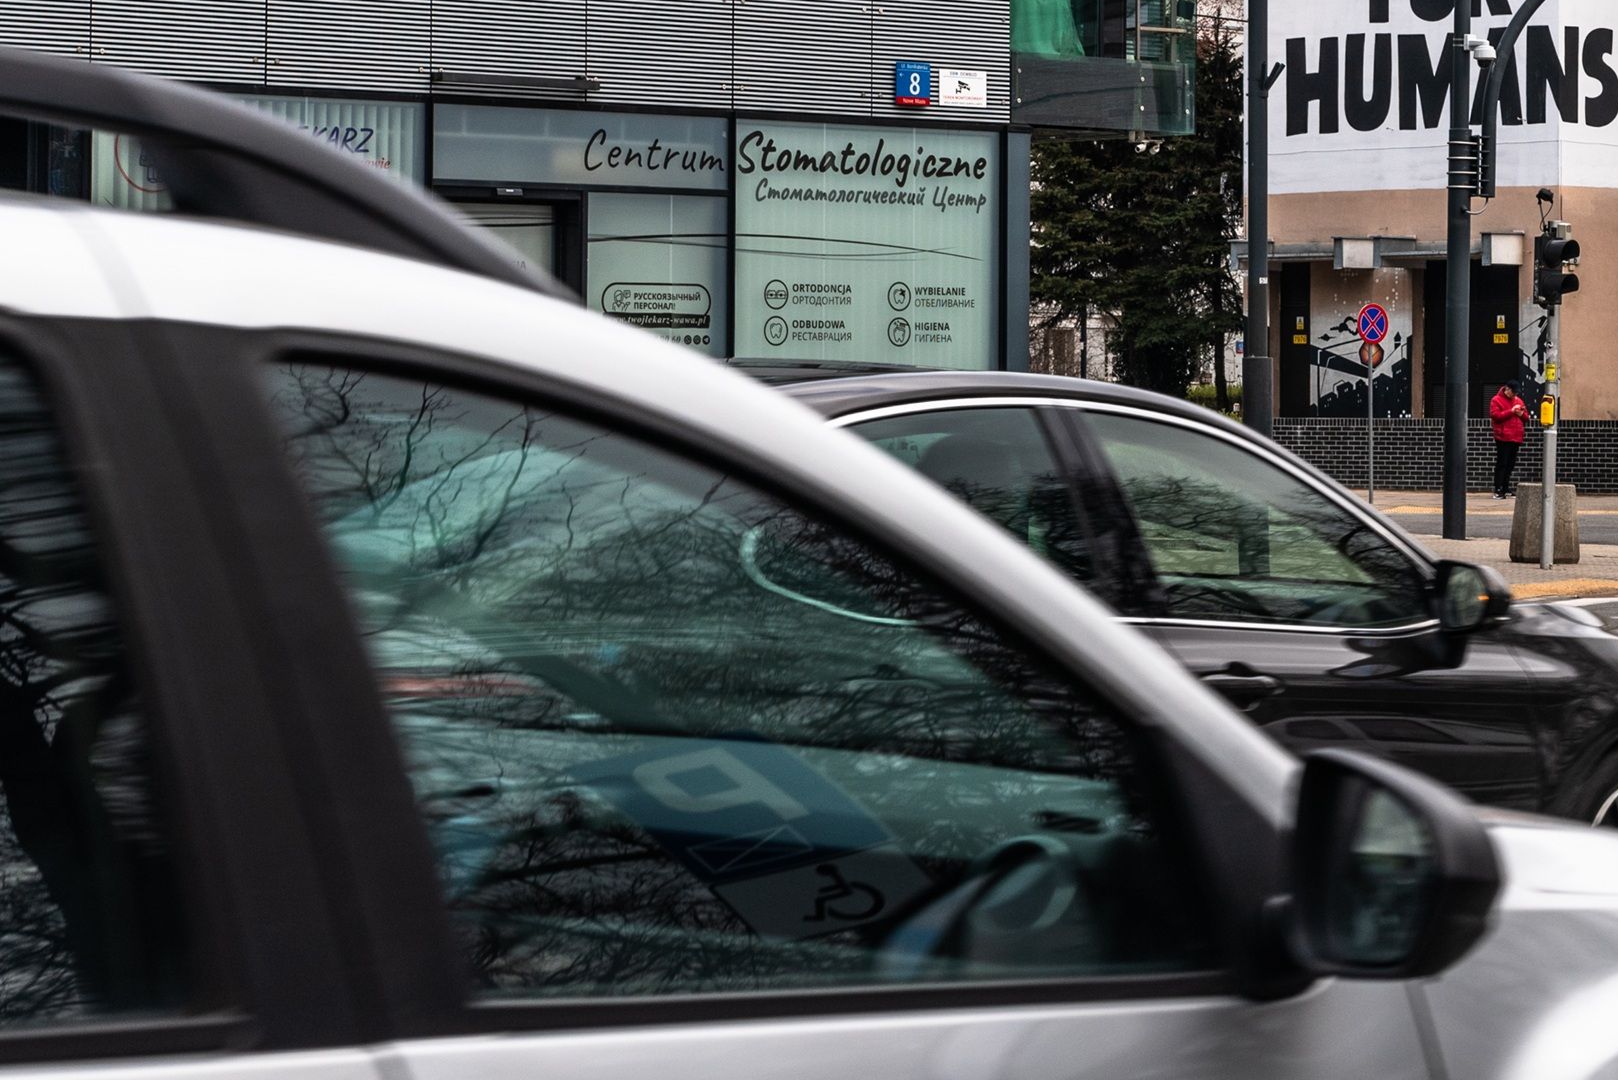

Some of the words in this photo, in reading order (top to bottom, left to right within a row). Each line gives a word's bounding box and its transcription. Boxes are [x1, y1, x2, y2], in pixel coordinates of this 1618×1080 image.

[909, 72, 921, 95] 8
[584, 128, 725, 174] Centrum
[738, 130, 988, 187] Stomatologiczne
[755, 178, 925, 206] Стоматологический
[932, 186, 988, 214] Центр
[792, 283, 852, 294] ORTODONCJA
[914, 287, 966, 296] WYBIELANIE
[792, 297, 852, 306] ОРТОДОНТИЯ
[914, 299, 975, 308] ОТБЕЛИВАНИЕ
[792, 320, 845, 329] ODBUDOWA
[914, 322, 950, 331] HIGIENA
[792, 332, 852, 342] РЕСТАВРАЦИЯ
[914, 333, 952, 343] ГИГИЕНА
